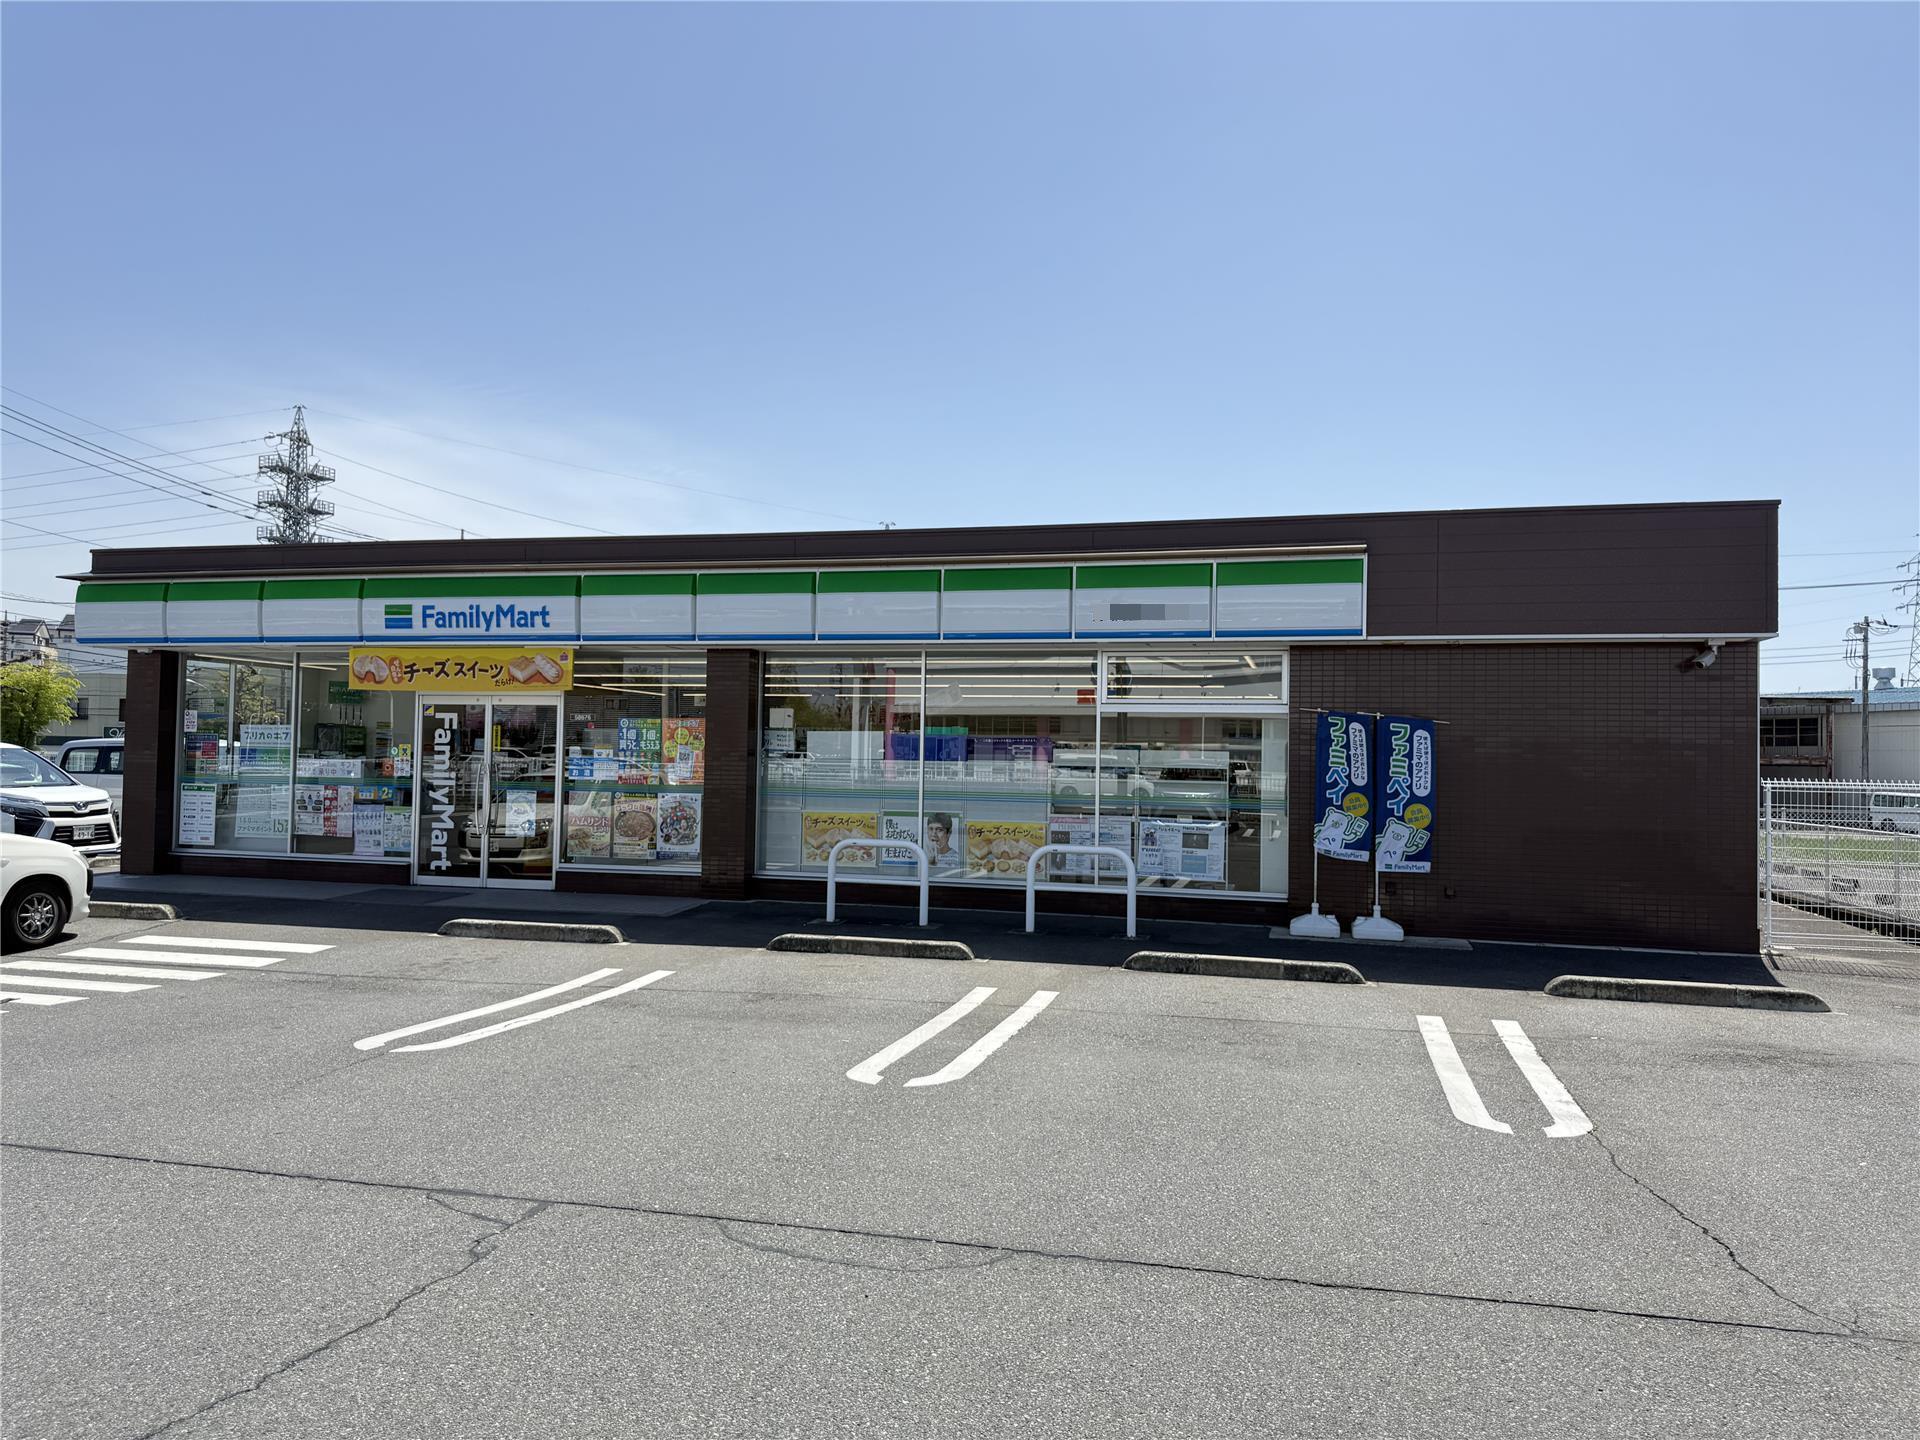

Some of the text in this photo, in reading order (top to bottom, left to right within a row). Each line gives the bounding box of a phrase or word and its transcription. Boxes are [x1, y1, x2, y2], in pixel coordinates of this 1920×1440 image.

[422, 603, 550, 632] FamilyMart
[403, 658, 450, 683] チーズ
[453, 660, 505, 680] スイーツ
[1326, 715, 1350, 806] ファミペイ
[1386, 722, 1411, 817] ファミペイ
[428, 712, 459, 871] FamilyMart
[1333, 850, 1363, 860] FamilyMart
[1394, 863, 1425, 872] FamilyMart
